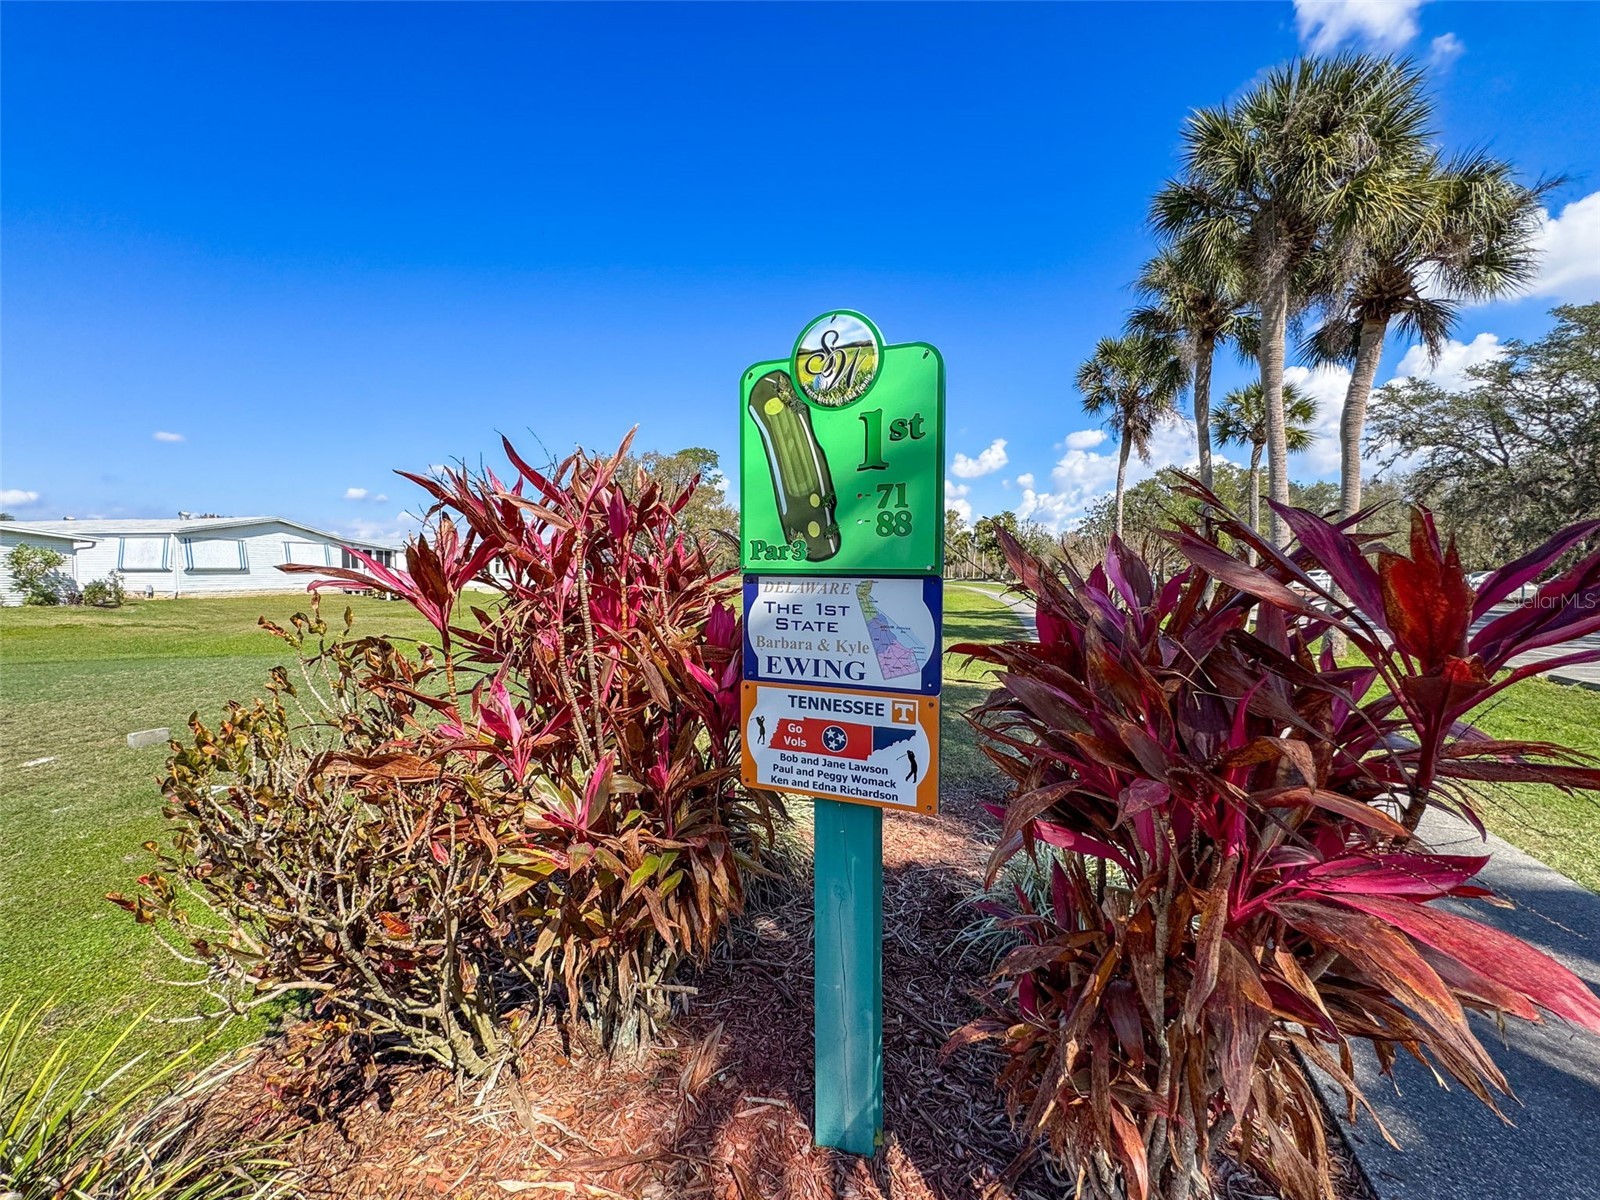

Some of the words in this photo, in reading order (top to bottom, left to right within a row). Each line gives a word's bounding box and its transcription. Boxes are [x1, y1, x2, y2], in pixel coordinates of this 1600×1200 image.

[857, 408, 926, 472] 1st
[876, 482, 908, 509] 71
[875, 510, 913, 537] 88
[763, 581, 851, 595] DELAWARE
[763, 601, 803, 615] THE
[816, 602, 850, 617] 1ST
[775, 617, 839, 633] STATE
[756, 635, 812, 651] Barbara
[817, 638, 830, 652] &
[835, 640, 870, 657] Kyle
[766, 655, 867, 681] EWING
[788, 694, 885, 717] TENNESSEE
[894, 703, 915, 722] T
[787, 722, 803, 734] Go
[783, 735, 807, 748] Vols
[779, 753, 799, 764] Bob
[801, 756, 820, 767] and
[821, 759, 846, 770] Jane
[849, 762, 889, 775] Lawson
[772, 764, 794, 775] Paul
[796, 767, 815, 778] and
[817, 770, 849, 784] Peggy
[851, 775, 897, 789] Womack
[770, 775, 789, 785] Ken
[791, 777, 811, 789] and
[812, 780, 838, 793] Edna
[839, 784, 899, 802] Richardson
